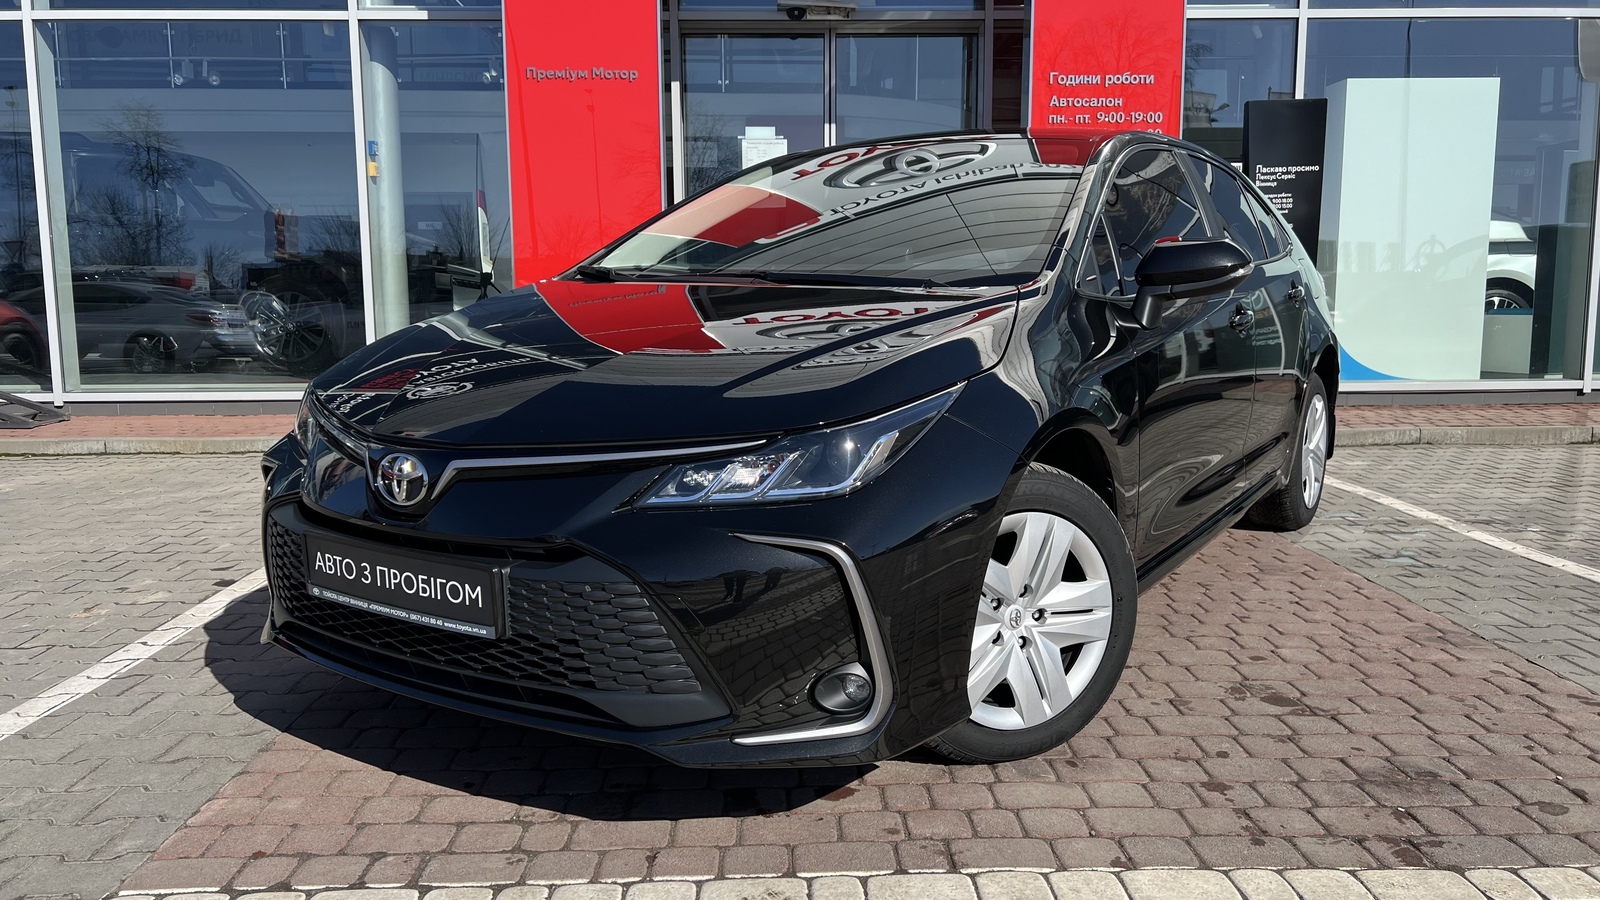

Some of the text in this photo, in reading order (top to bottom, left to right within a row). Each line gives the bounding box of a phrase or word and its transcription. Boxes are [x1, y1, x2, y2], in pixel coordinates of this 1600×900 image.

[526, 66, 639, 83] Преміум Мотор
[1049, 72, 1155, 88] Години роботи
[1049, 95, 1123, 108] Автосалон
[1096, 111, 1163, 124] 9:00-19:00
[1256, 164, 1320, 174] Ласкаво просимо
[314, 551, 483, 608] АВТО З ПРОБІГОМ
[410, 613, 422, 622] (067)
[422, 616, 430, 624] 431
[444, 622, 487, 635] www.toyota.vn.ua
